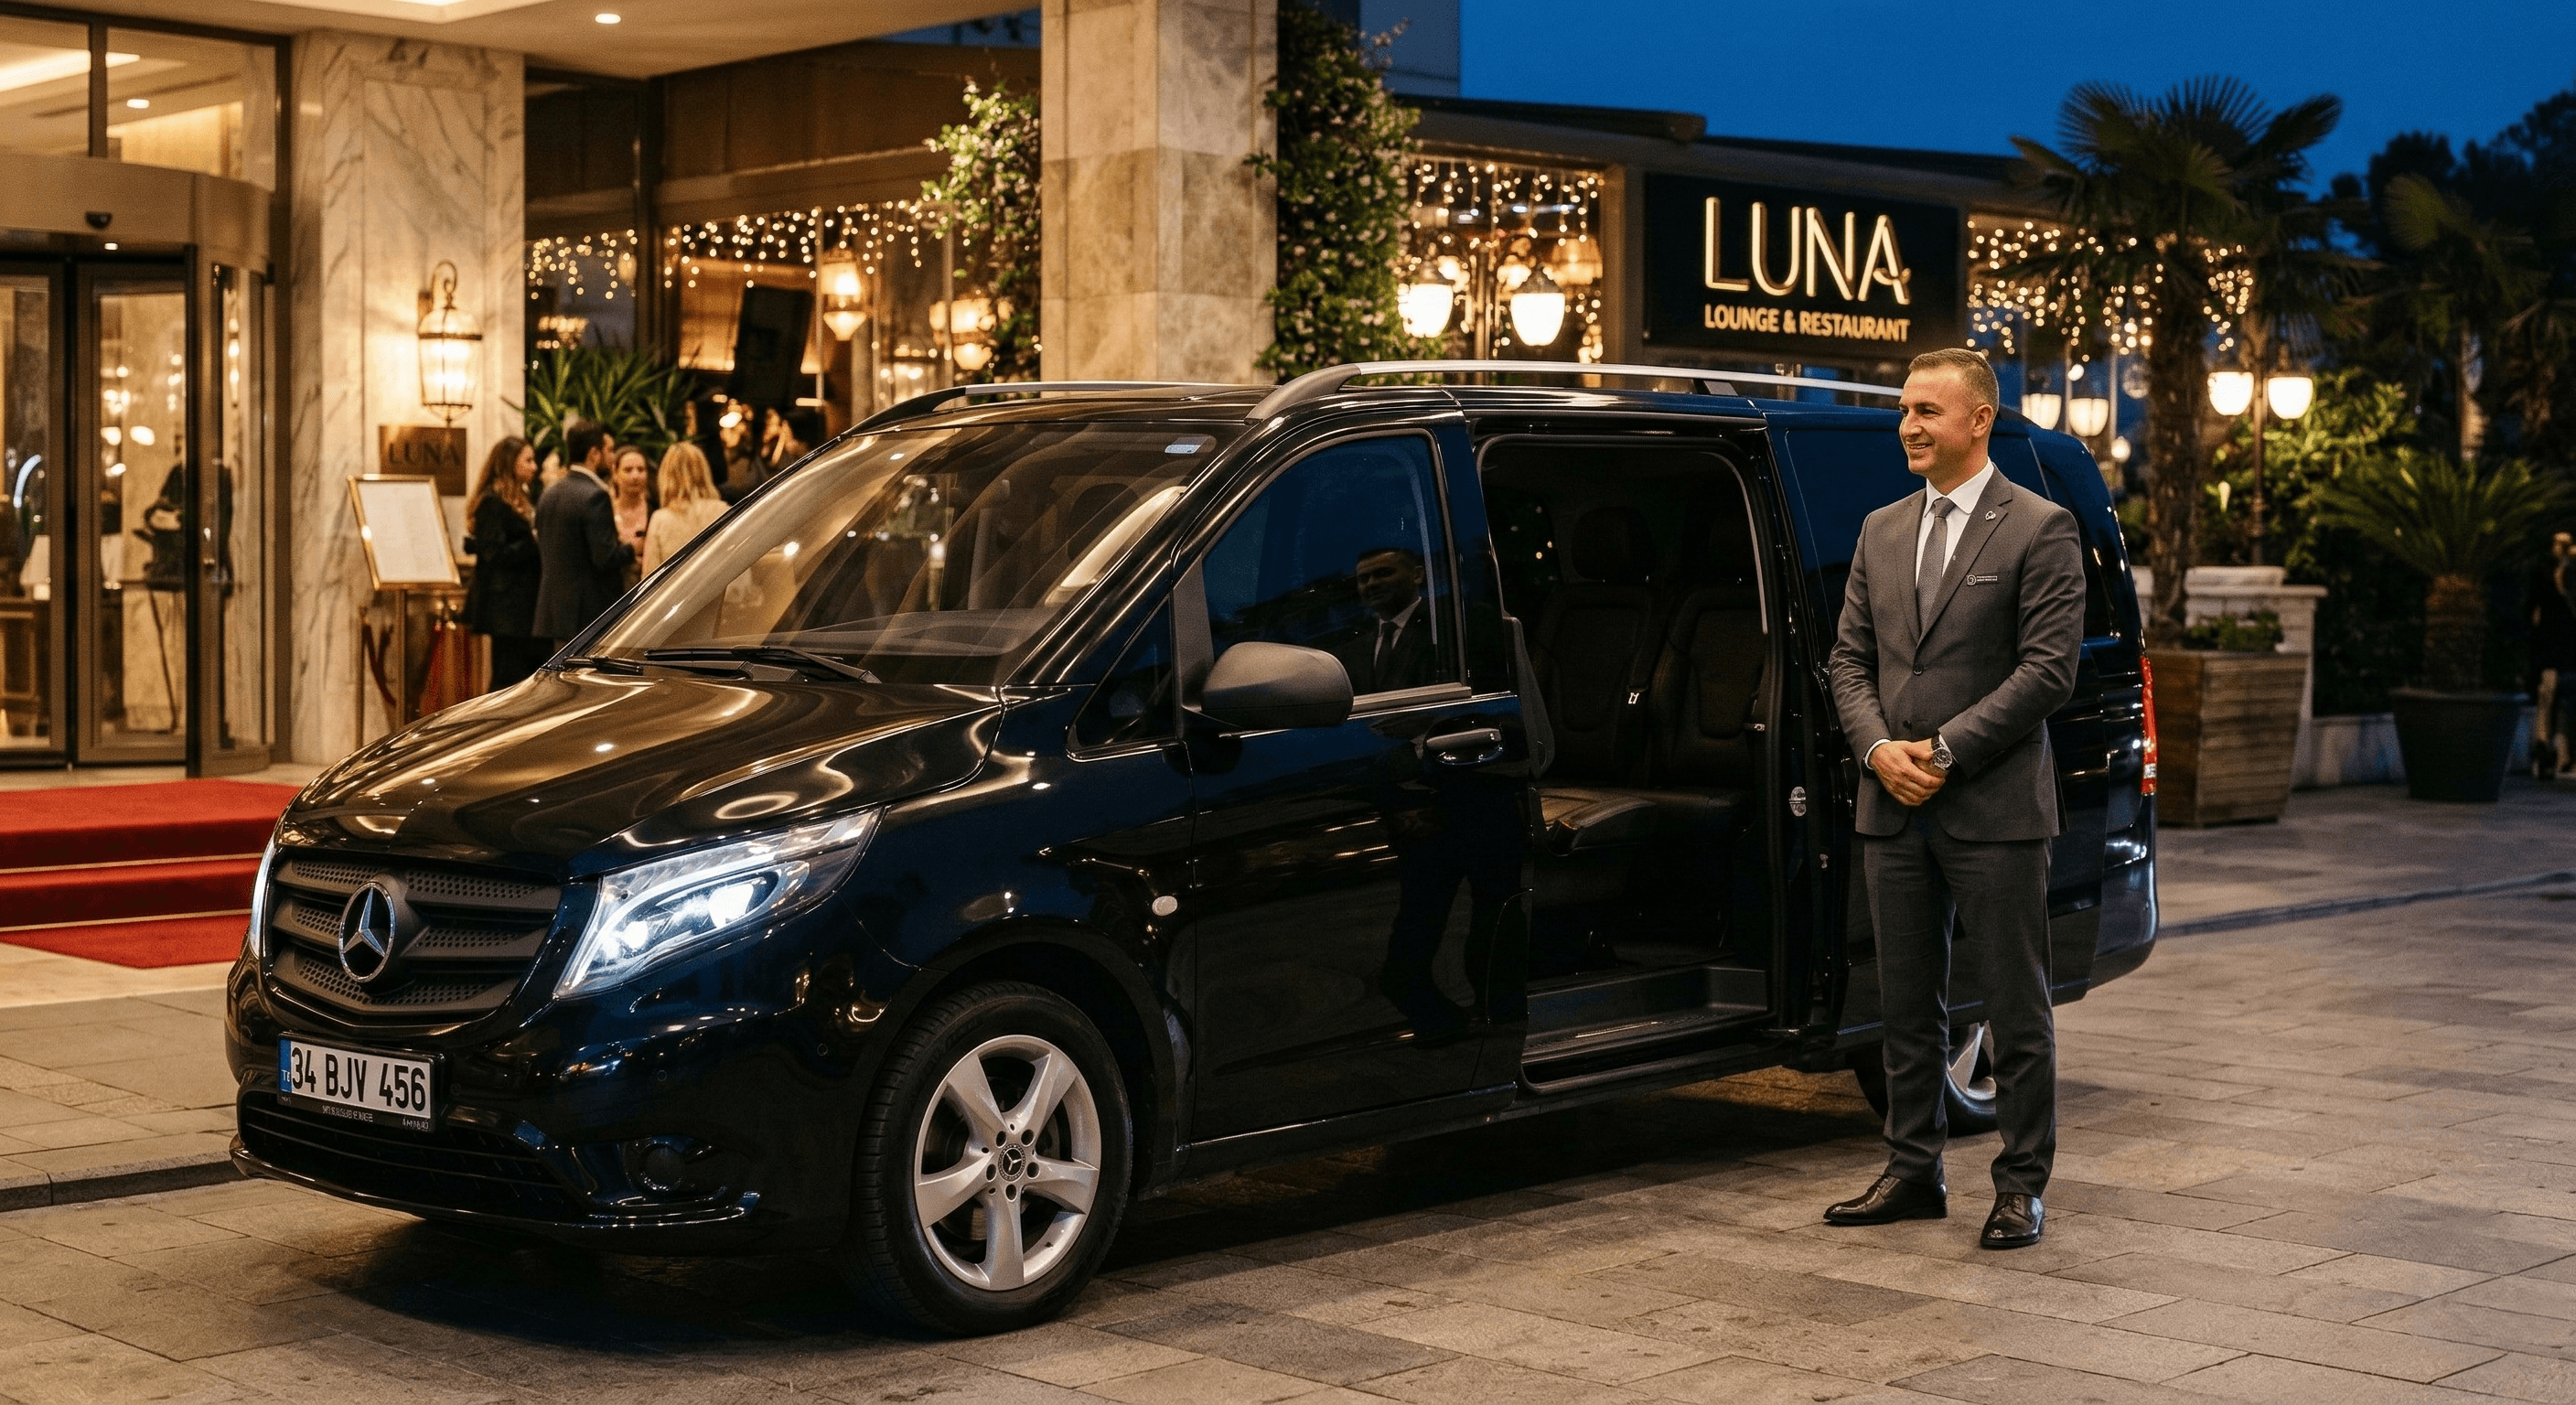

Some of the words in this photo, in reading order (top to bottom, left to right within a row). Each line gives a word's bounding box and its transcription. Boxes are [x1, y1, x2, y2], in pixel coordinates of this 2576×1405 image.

[1705, 197, 1911, 305] LUNA
[1705, 304, 1780, 332] LOUNGE
[1783, 309, 1797, 333] &
[1799, 311, 1910, 342] RESTAURANT
[388, 442, 461, 467] LUNA
[292, 1047, 317, 1093] 34
[326, 1054, 367, 1102] BJV
[379, 1063, 425, 1111] 456
